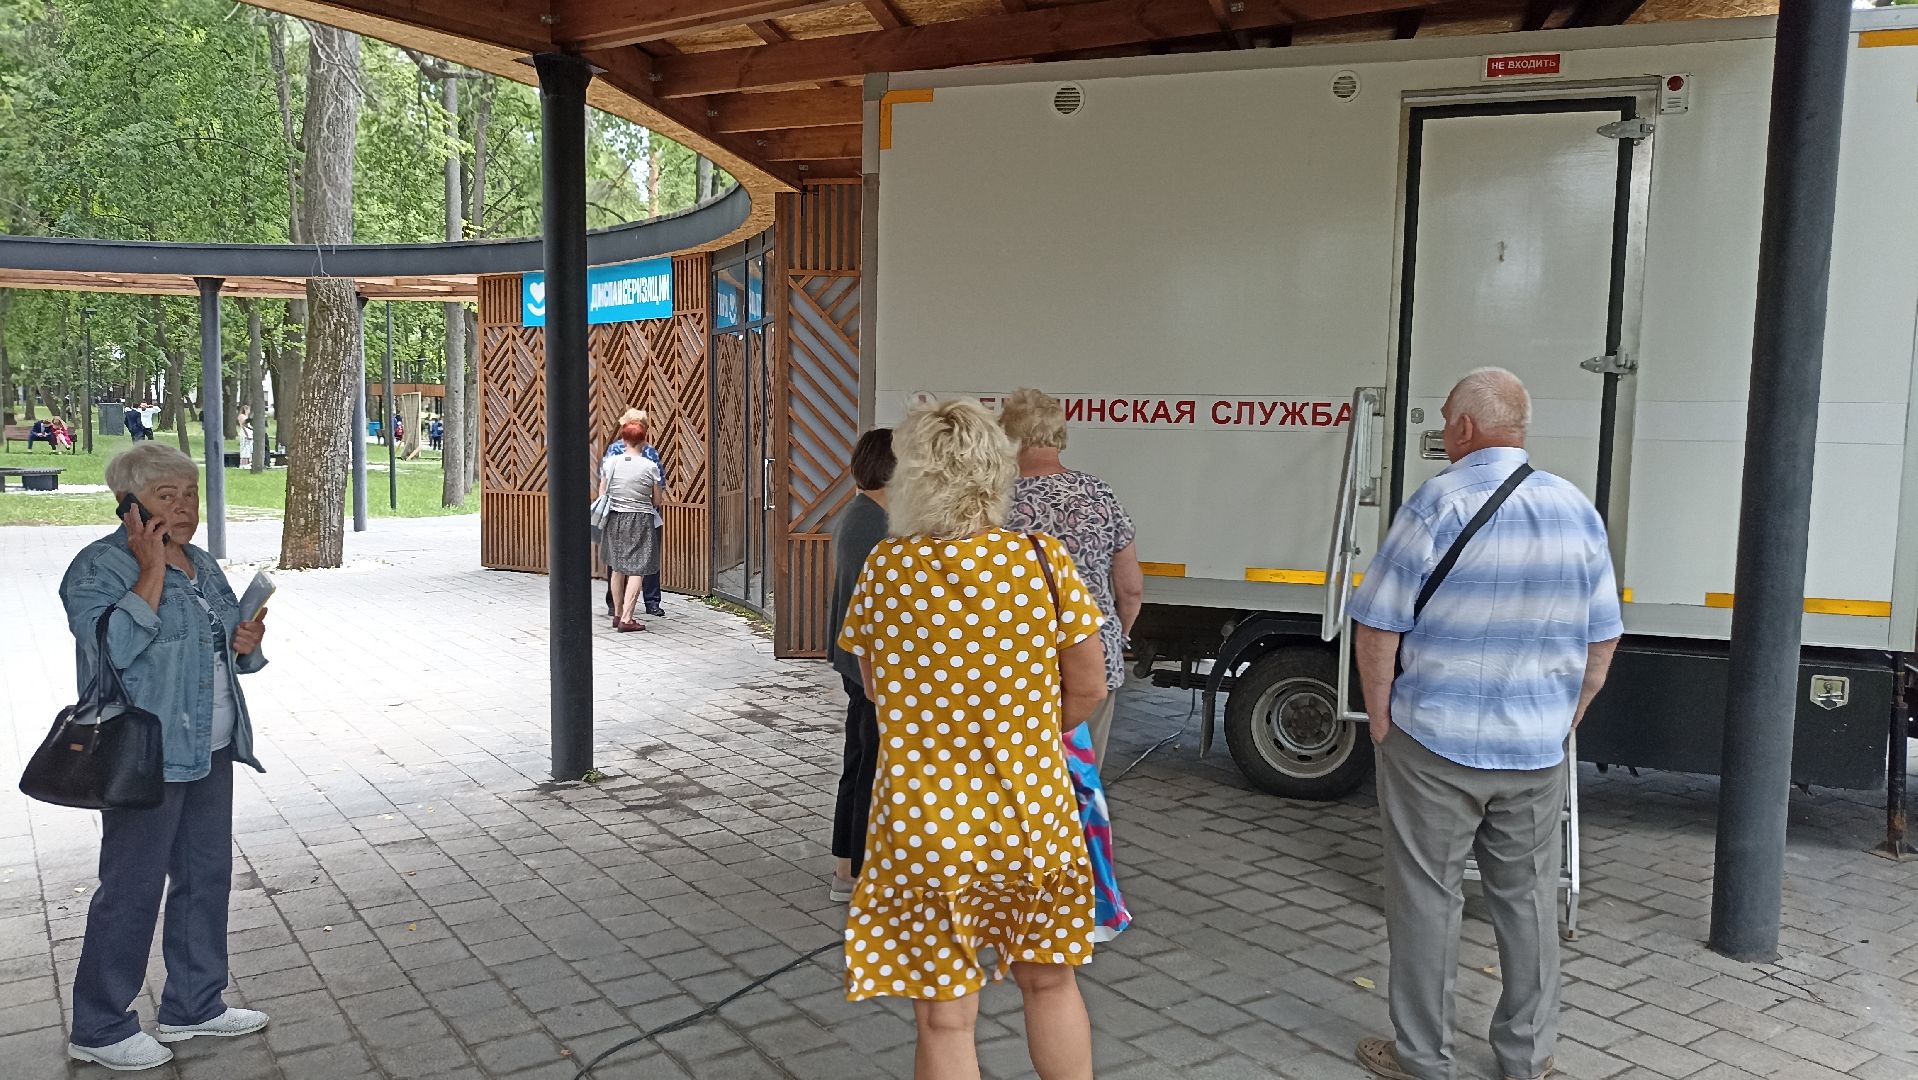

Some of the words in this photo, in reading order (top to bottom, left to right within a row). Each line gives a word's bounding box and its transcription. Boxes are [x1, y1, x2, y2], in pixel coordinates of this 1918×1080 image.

[1491, 61, 1505, 70] НЕ
[1507, 59, 1557, 69] ВХОДИТЬ
[1211, 400, 1353, 427] СЛУЖБА
